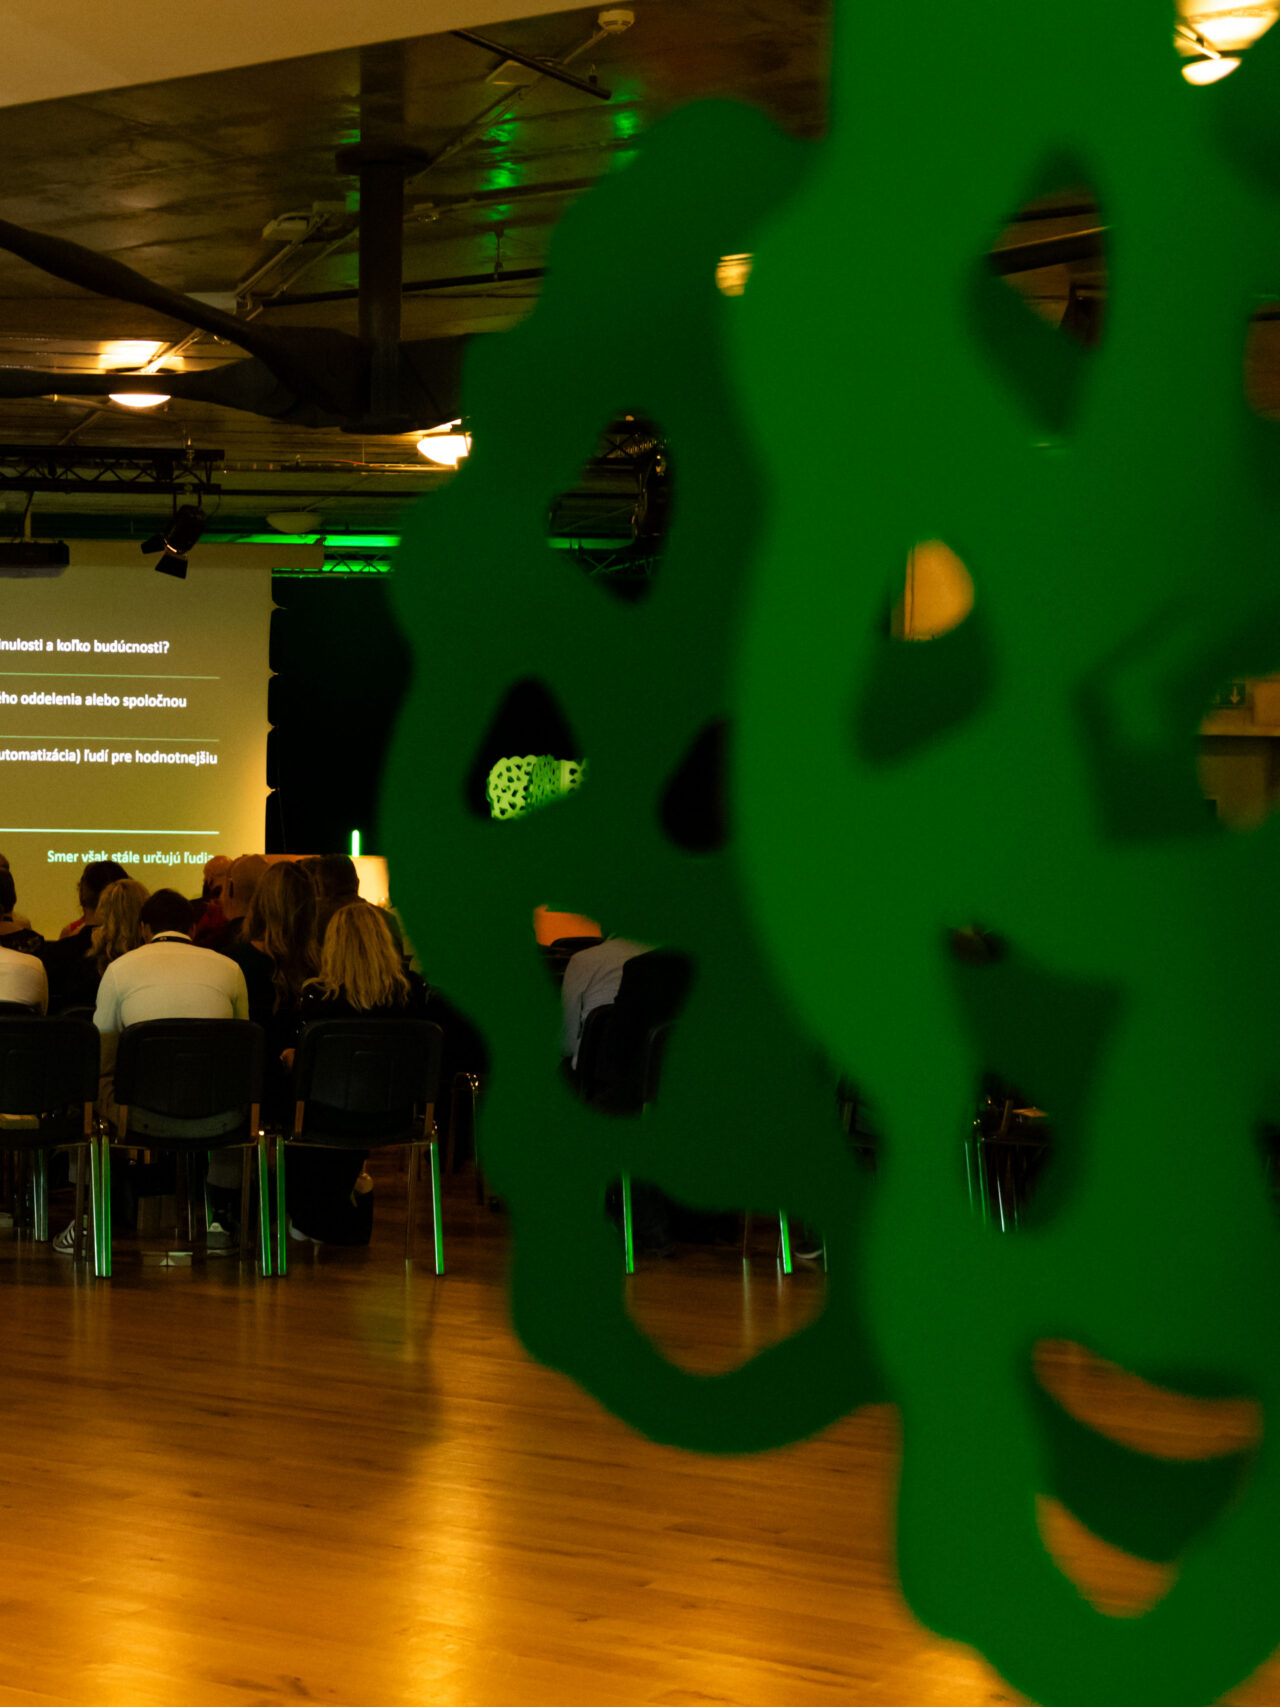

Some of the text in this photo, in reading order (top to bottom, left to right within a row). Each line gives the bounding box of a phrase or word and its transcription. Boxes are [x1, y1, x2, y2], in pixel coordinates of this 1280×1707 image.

[46, 641, 54, 651] a
[56, 639, 91, 652] koľko
[94, 639, 170, 654] budúcnosti?
[20, 692, 82, 706] oddelenia
[85, 692, 120, 706] alebo
[122, 694, 187, 709] spoločnou
[84, 749, 108, 763] ľudí
[111, 753, 132, 765] pre
[135, 750, 218, 766] hodnotnejšiu
[47, 850, 79, 863] Smer
[81, 850, 109, 863] však
[111, 851, 140, 864] stále
[143, 851, 181, 866] určujú
